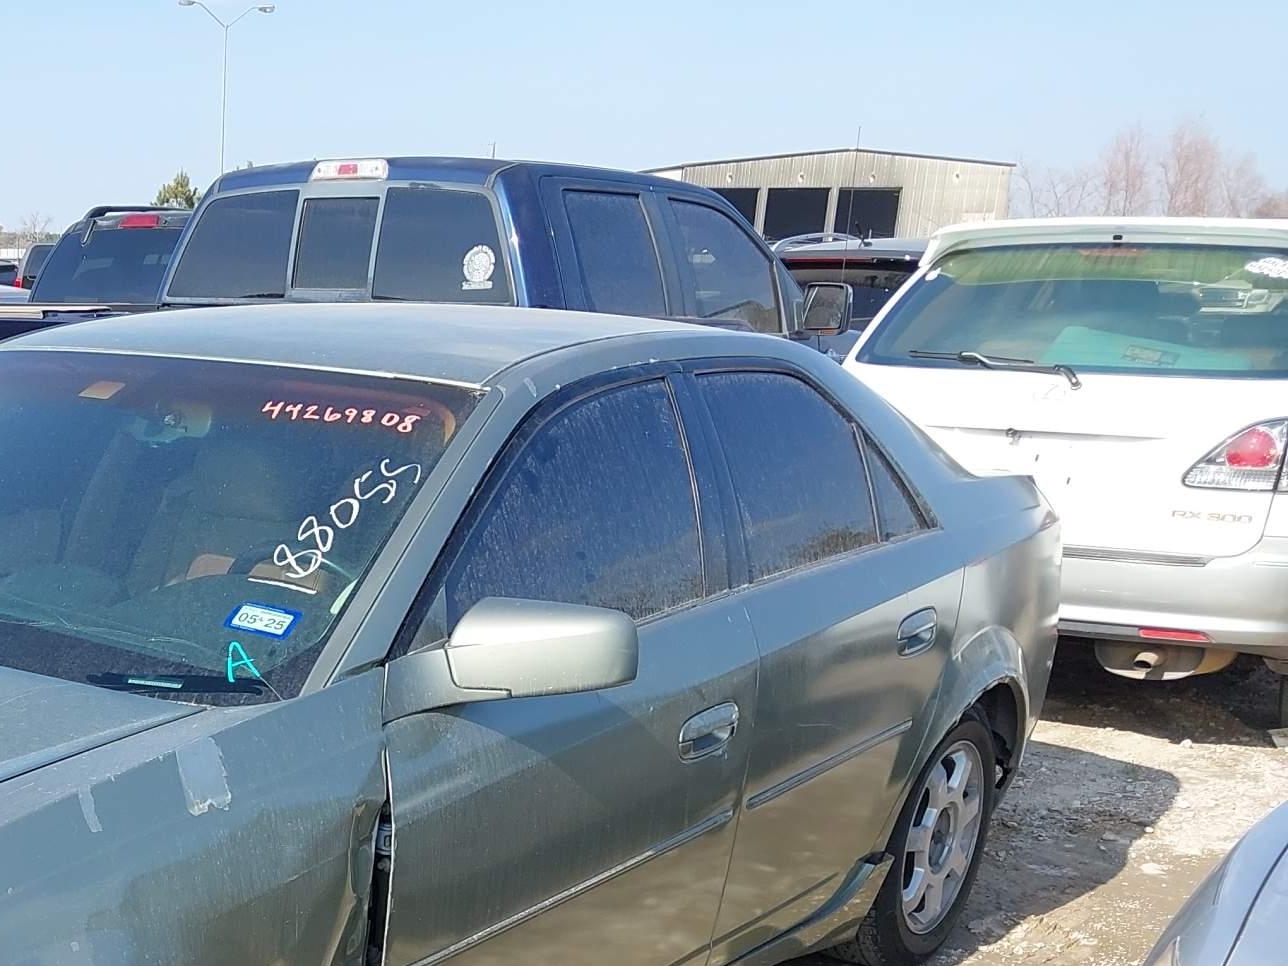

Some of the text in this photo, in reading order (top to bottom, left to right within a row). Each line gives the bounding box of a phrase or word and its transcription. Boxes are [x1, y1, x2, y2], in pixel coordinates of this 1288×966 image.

[262, 400, 423, 433] 44269808
[1171, 509, 1253, 524] RX 300
[238, 612, 260, 625] 05
[263, 618, 287, 631] 25
[226, 640, 261, 683] A
